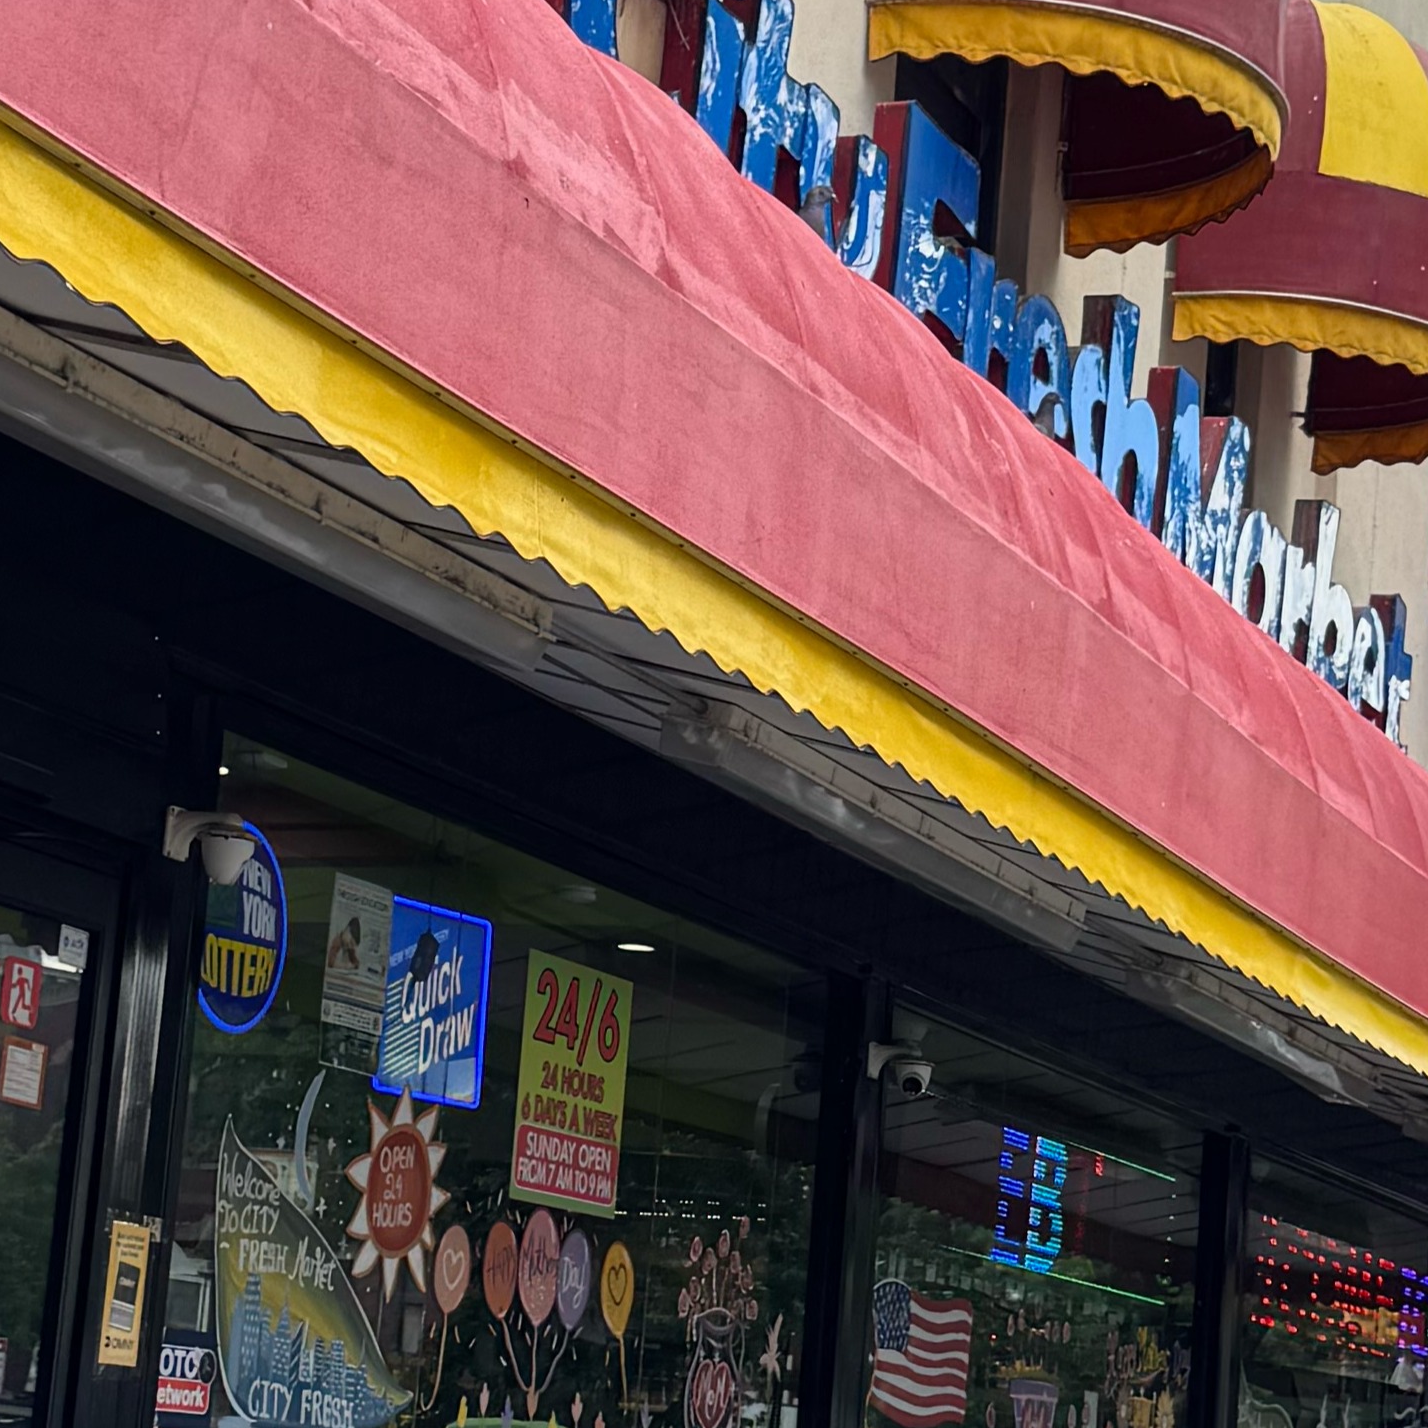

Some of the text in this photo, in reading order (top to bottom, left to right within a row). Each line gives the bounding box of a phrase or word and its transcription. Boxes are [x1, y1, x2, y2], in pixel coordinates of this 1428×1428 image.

[243, 858, 271, 899] NEW
[243, 892, 276, 941] YORK
[402, 945, 464, 1023] Quick
[534, 969, 619, 1066] 24/6
[418, 1004, 476, 1074] Draw
[541, 1060, 605, 1103] 24 HOURS
[521, 1093, 618, 1141] 6 DAYS A WEEK
[380, 1144, 416, 1171] OPEN
[526, 1132, 611, 1170] SUNDAY OPEN
[223, 1153, 280, 1205] Welcome
[383, 1174, 403, 1200] 24
[518, 1156, 547, 1186] FROM
[549, 1164, 556, 1188] 7
[557, 1166, 572, 1191] AM
[574, 1170, 586, 1194] TO
[596, 1174, 611, 1199] PM
[240, 1203, 279, 1235] CITY
[373, 1203, 412, 1228] HOURS
[239, 1236, 337, 1291] FRESH Market
[159, 1348, 200, 1378] OTC
[157, 1384, 204, 1407] etwork
[248, 1380, 297, 1420] CITY
